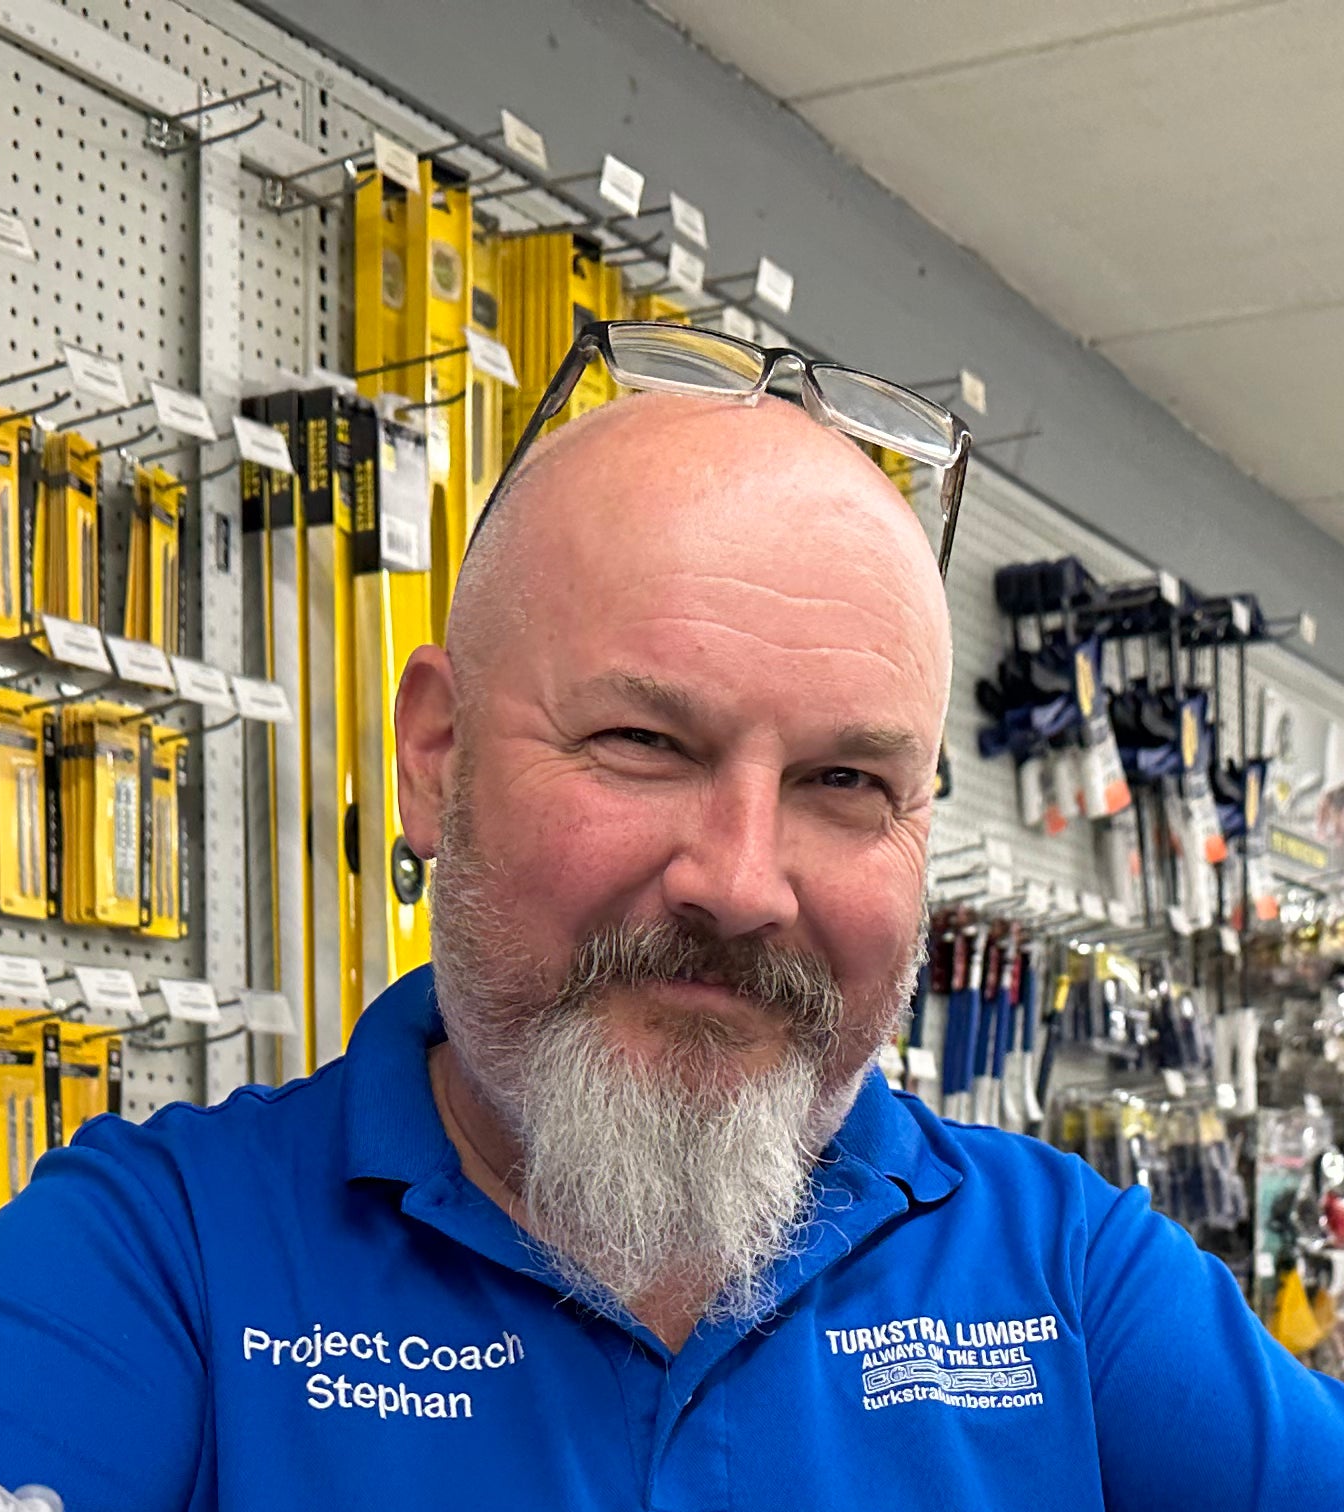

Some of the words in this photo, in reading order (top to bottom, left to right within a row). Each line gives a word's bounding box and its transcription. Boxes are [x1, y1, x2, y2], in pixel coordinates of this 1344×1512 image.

[243, 1324, 392, 1367] Project
[399, 1331, 526, 1371] Coach
[825, 1316, 951, 1355] TURKSTRA
[955, 1315, 1059, 1348] LUMBER
[861, 1342, 927, 1370] ALWAYS
[946, 1349, 979, 1366] THE
[981, 1346, 1032, 1367] LEVEL
[306, 1374, 474, 1420] Stephan
[862, 1385, 1044, 1411] turkstralumber.com
